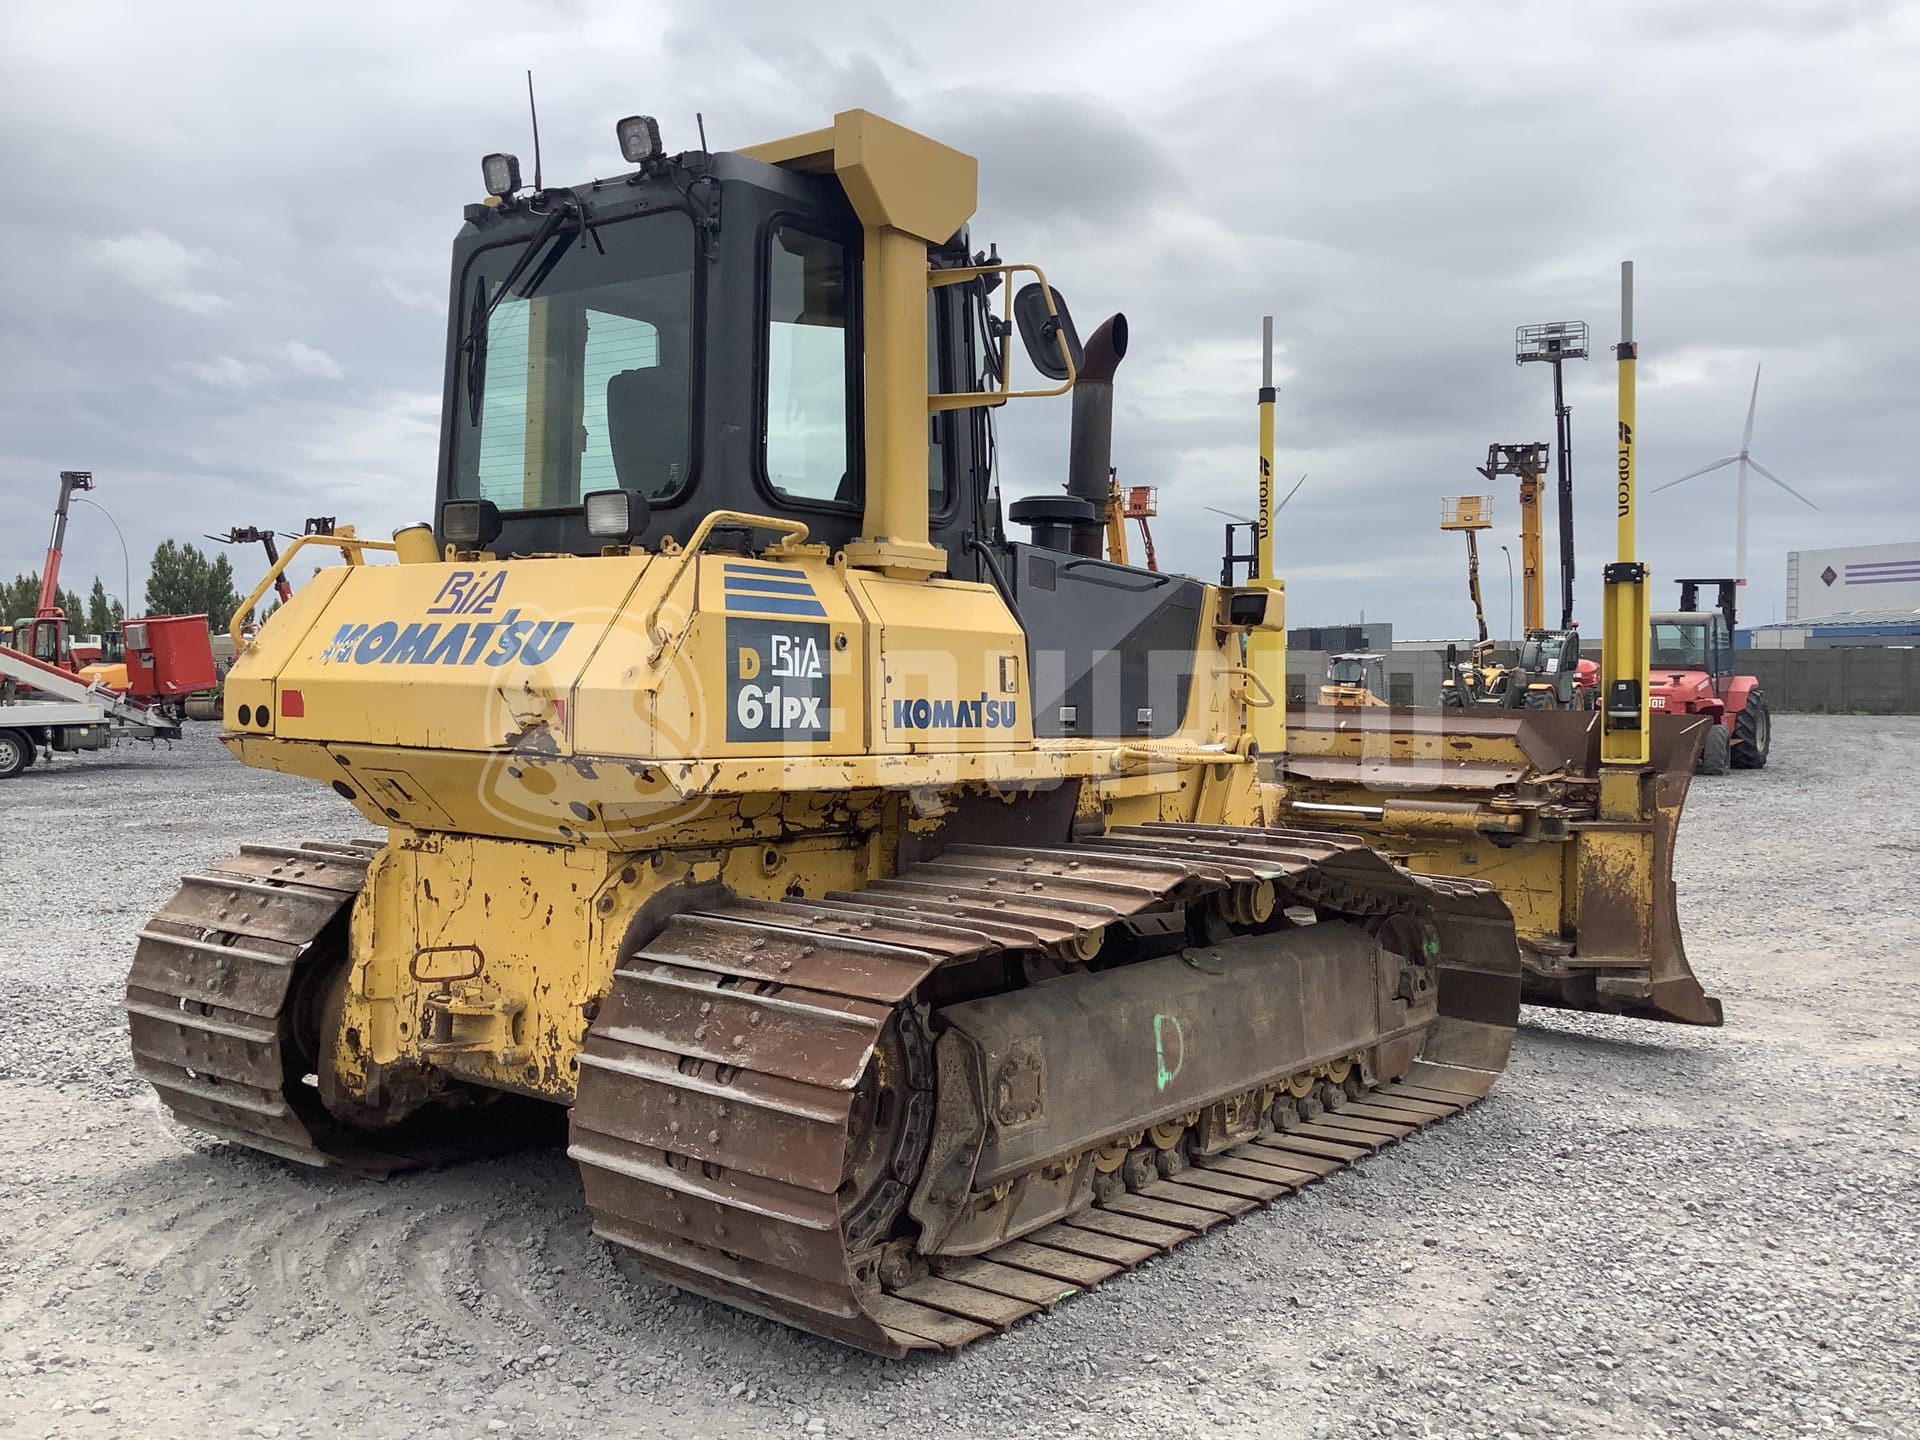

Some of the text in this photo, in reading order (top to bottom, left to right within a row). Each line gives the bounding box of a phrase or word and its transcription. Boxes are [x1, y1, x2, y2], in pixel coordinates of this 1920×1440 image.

[1259, 478, 1269, 539] TOPCON
[1618, 446, 1630, 518] TOPCON
[319, 609, 575, 667] KOMATSU
[738, 647, 761, 680] D
[737, 684, 822, 730] 61PX
[893, 692, 1016, 729] KOMATSU
[1153, 1013, 1184, 1091] D
